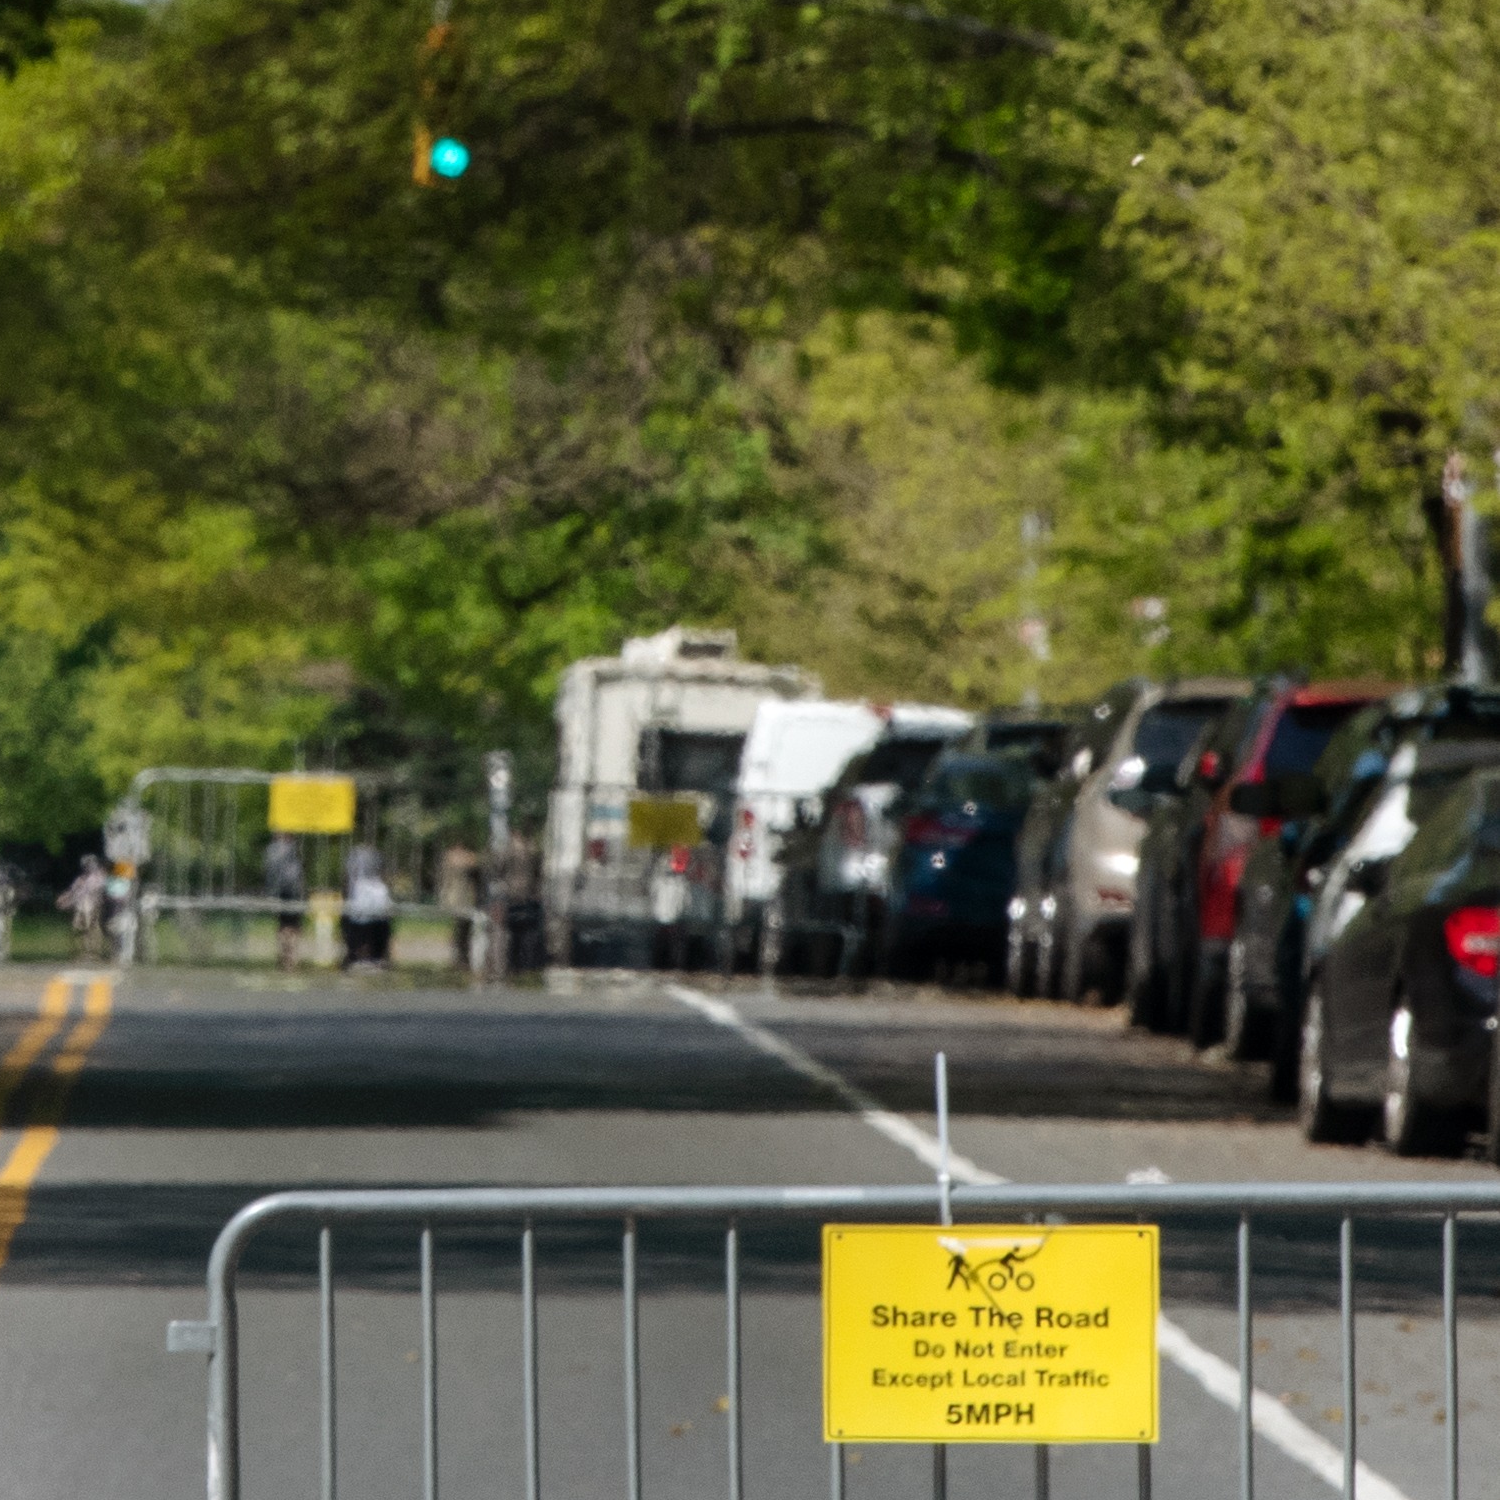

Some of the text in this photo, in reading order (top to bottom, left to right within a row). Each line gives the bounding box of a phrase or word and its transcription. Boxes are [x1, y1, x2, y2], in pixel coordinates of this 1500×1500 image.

[871, 1304, 1110, 1329] Share The Road
[913, 1340, 1069, 1359] Do Not Enter
[871, 1368, 1110, 1391] Except Local Traffic
[946, 1402, 1036, 1426] 5MPH
